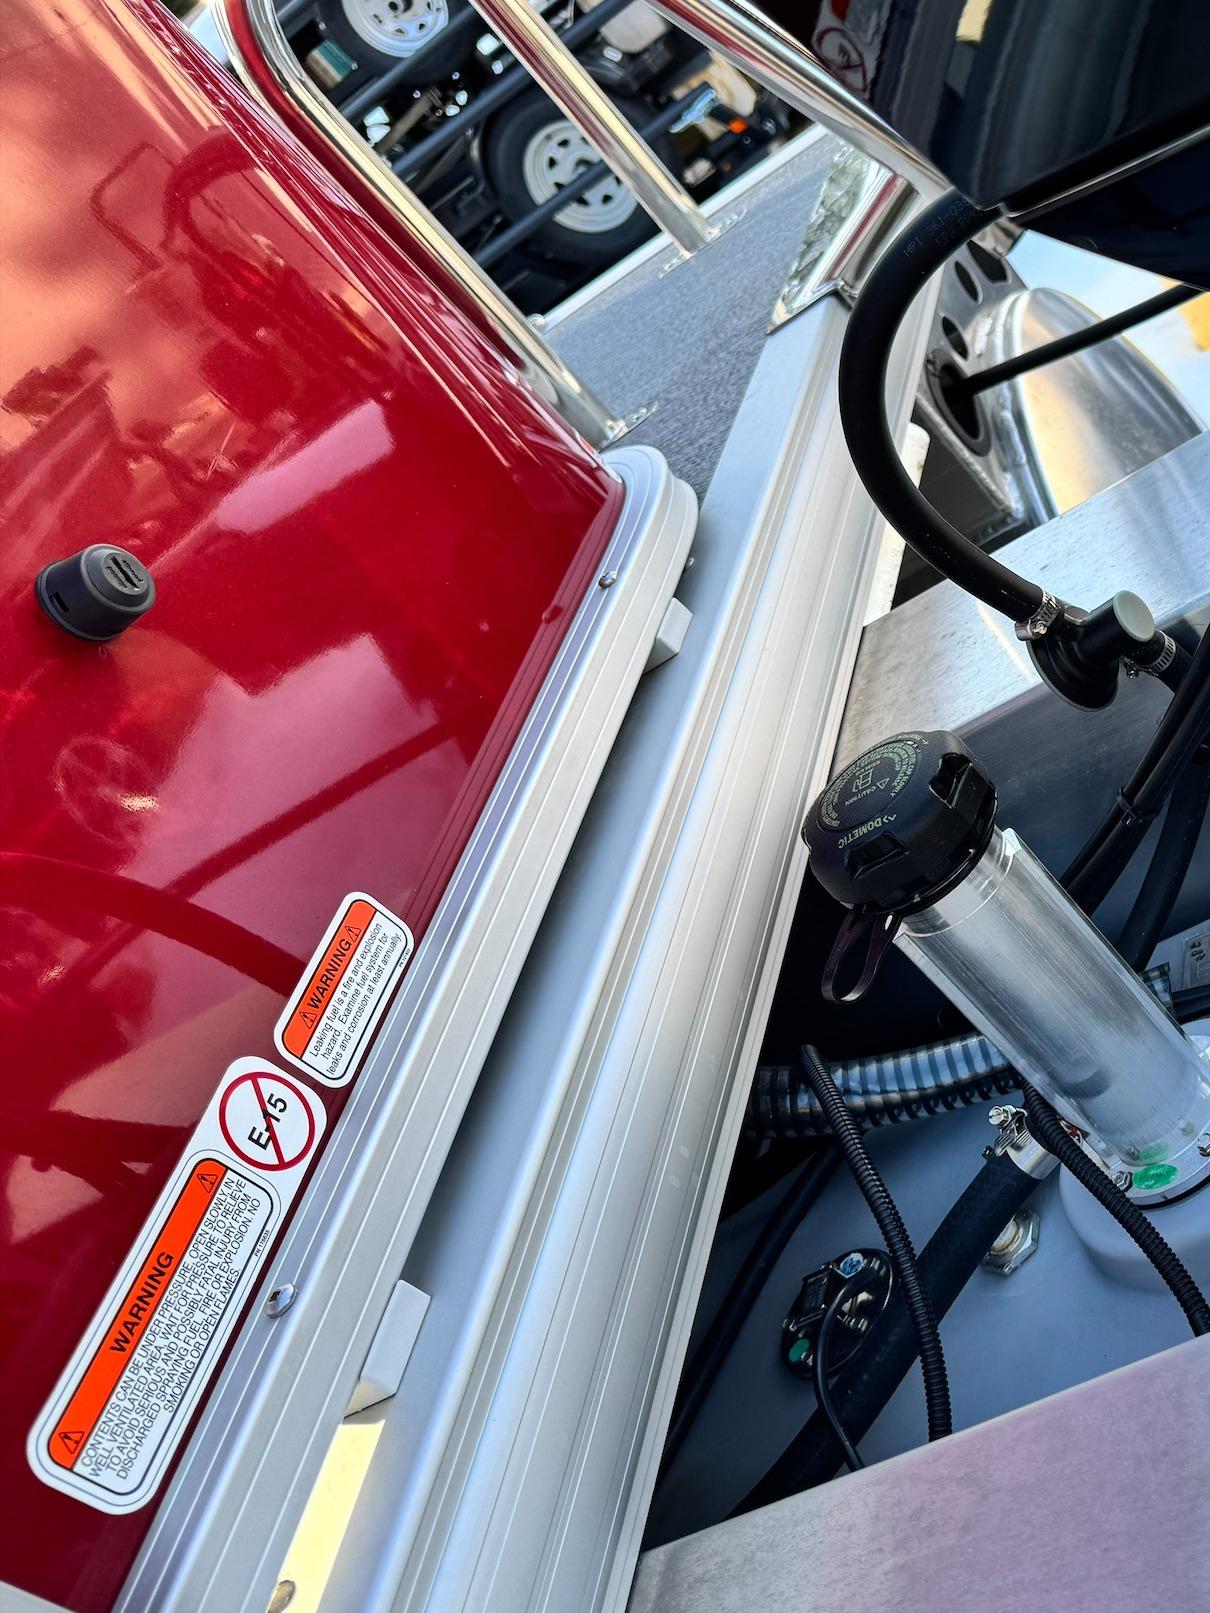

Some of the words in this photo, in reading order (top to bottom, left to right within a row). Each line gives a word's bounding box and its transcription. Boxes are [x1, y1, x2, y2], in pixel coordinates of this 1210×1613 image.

[844, 786, 876, 807] CAUTION
[837, 817, 883, 849] DOMETIC
[359, 923, 383, 960] explosion
[381, 932, 402, 966] annually.
[306, 938, 352, 1010] WARNING
[342, 976, 355, 990] fire
[351, 958, 363, 977] and
[369, 964, 385, 985] least
[320, 1028, 342, 1060] hazard.
[337, 988, 361, 1025] Examine
[355, 970, 369, 989] fuel
[365, 944, 383, 973] system
[377, 932, 389, 945] for
[334, 997, 344, 1006] is
[340, 990, 348, 998] a
[366, 984, 375, 995] at
[326, 1004, 340, 1023] fuel
[347, 994, 371, 1033] corrosion
[308, 1022, 334, 1057] Leaking
[339, 1031, 352, 1052] and
[325, 1051, 343, 1075] leaks
[247, 1093, 288, 1151] E-15
[109, 1251, 174, 1352] WARNING
[80, 1401, 122, 1467] CONTENTS
[115, 1374, 135, 1402] CAN
[128, 1357, 144, 1376] BE
[136, 1318, 165, 1358] UNDER
[157, 1261, 196, 1319] PRESSURE,
[188, 1228, 210, 1259] OPEN
[203, 1188, 231, 1230] SLOWLY,
[223, 1177, 235, 1190] IN
[88, 1446, 114, 1477] WELL
[105, 1375, 148, 1442] VENTILATED
[143, 1344, 167, 1376] AREA,
[158, 1312, 179, 1340] WAIT
[173, 1289, 192, 1314] FOR
[185, 1233, 220, 1290] PRESSURE
[212, 1219, 226, 1234] TO
[220, 1178, 247, 1220] RELIEVE
[104, 1454, 122, 1472] TO
[115, 1417, 140, 1455] AVOID
[134, 1365, 167, 1417] SERIOUS
[161, 1341, 179, 1367] AND
[172, 1288, 204, 1341] POSSIBLY
[198, 1260, 220, 1290] FATAL
[213, 1221, 236, 1259] INJURY
[230, 1192, 252, 1224] FROM
[115, 1402, 161, 1480] DISCHARGED
[155, 1346, 189, 1402] SPRAYING
[182, 1317, 208, 1347] FUEL,
[198, 1289, 217, 1315] FIRE
[210, 1272, 225, 1290] OR
[218, 1216, 253, 1274] EXPLOSION.
[246, 1198, 261, 1216] NO
[163, 1359, 198, 1413] SMOKING
[189, 1340, 205, 1359] OR
[198, 1309, 220, 1341] OPEN
[213, 1268, 243, 1310] FLAMES.
